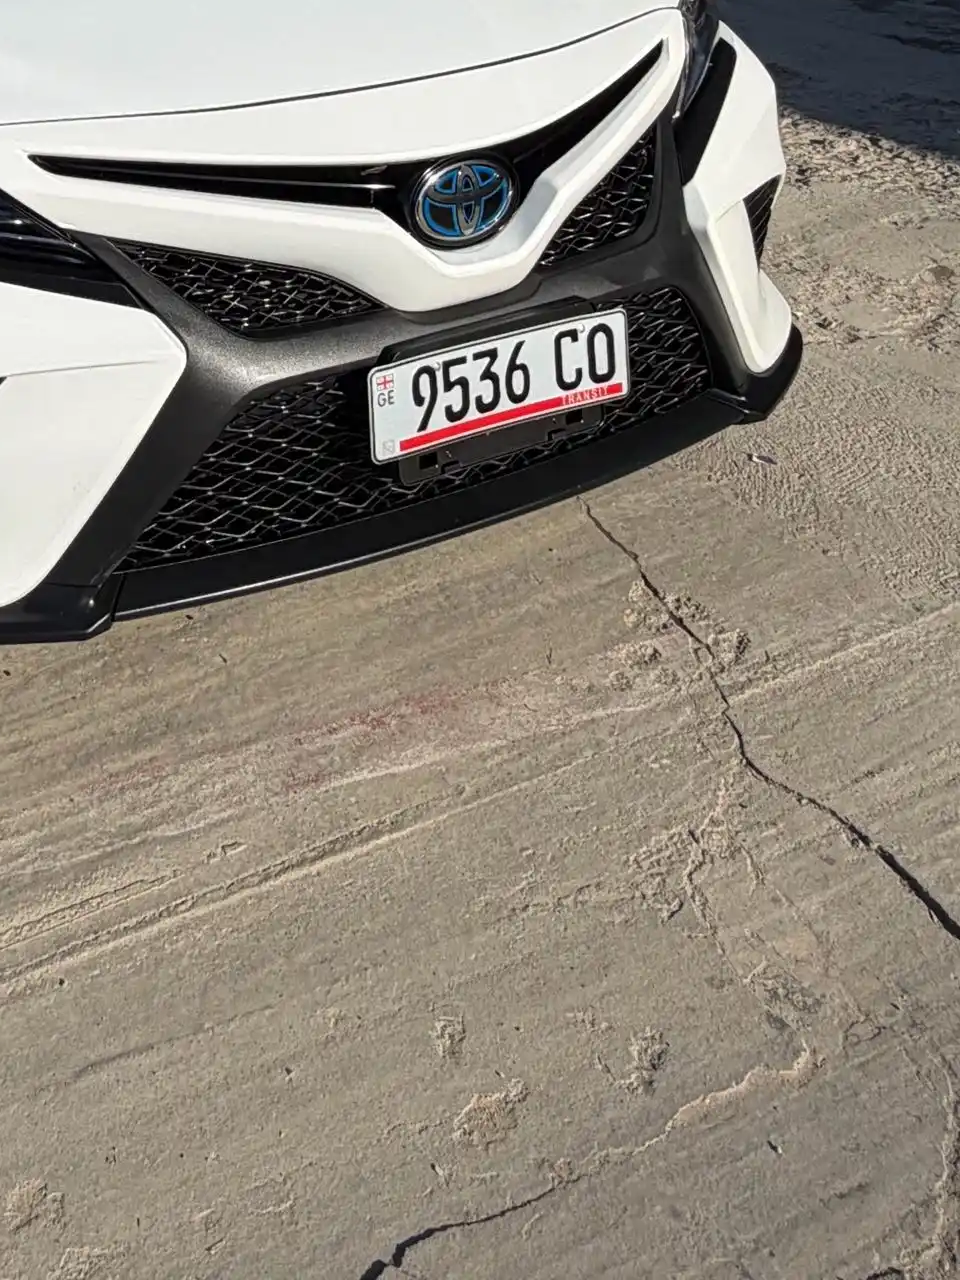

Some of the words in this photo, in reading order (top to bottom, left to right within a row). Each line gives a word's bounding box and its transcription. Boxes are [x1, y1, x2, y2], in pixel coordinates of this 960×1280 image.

[411, 339, 531, 433] 9536
[554, 322, 616, 391] CO
[377, 390, 395, 408] GE
[561, 385, 609, 407] TRANSIT
